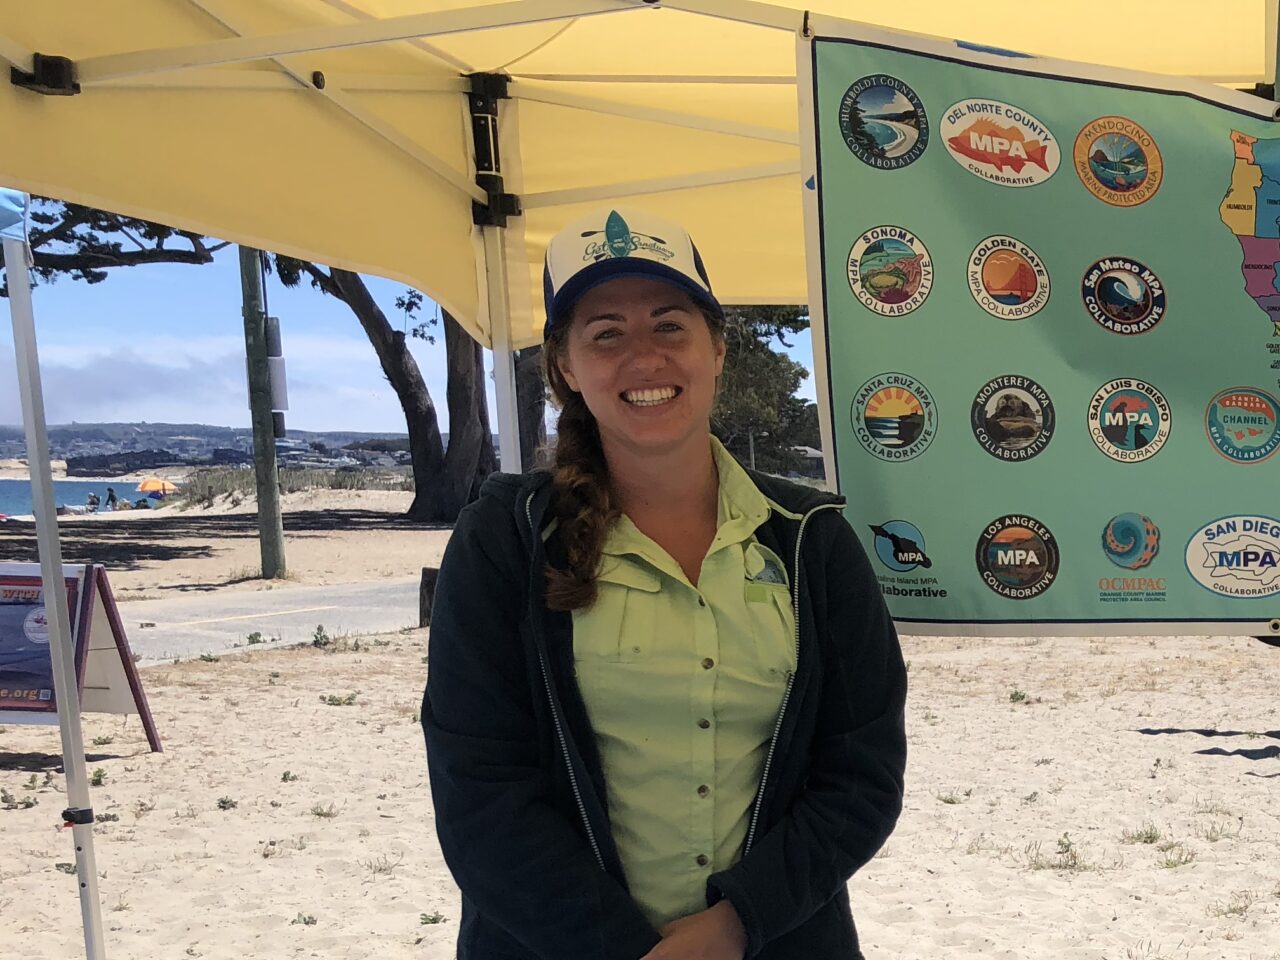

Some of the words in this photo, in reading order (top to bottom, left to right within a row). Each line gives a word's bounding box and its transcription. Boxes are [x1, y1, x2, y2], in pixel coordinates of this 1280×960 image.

[842, 77, 876, 120] HUMBOLDT
[880, 77, 918, 104] COUNTY
[947, 108, 966, 124] DEL
[966, 104, 1002, 115] NORTE
[1005, 109, 1051, 142] COUNTY
[1085, 121, 1150, 147] MENDOCINO
[847, 138, 925, 168] COLLABORATIVE
[970, 130, 1028, 159] MPA
[968, 163, 1034, 184] COLLABORATIVE
[862, 228, 915, 246] SONOMA
[973, 239, 1016, 266] GOLDEN
[1020, 248, 1045, 277] GATE
[850, 258, 859, 285] MPA
[858, 260, 931, 314] COLLABORATIVE
[1085, 269, 1101, 288] San
[1100, 260, 1139, 273] Mateo
[1141, 270, 1162, 297] MPA
[971, 271, 982, 296] MPA
[981, 282, 1048, 316] COLLABORATIVE
[1086, 296, 1162, 333] COLLABORATIVE
[857, 379, 884, 405] SANTA
[887, 376, 914, 389] CRUZ
[914, 386, 931, 408] MPA
[977, 377, 1030, 404] MONTEREY
[1030, 385, 1049, 407] MPA
[1091, 394, 1104, 421] SAN
[1104, 381, 1132, 394] LUIS
[1136, 382, 1169, 422] OBISPO
[1105, 412, 1153, 426] MPA
[1223, 415, 1269, 425] CHANNEL
[858, 427, 932, 458] COLLABORATIVE
[976, 428, 1050, 458] COLLABORATIVE
[1092, 427, 1166, 460] COLLABORATIVE
[1211, 427, 1222, 444] MPA
[984, 521, 1003, 539] LOS
[1005, 517, 1050, 540] ANGELES
[1205, 520, 1237, 541] SAN
[898, 552, 924, 562] MPA
[997, 550, 1040, 565] MPA
[1218, 551, 1277, 567] MPA
[984, 571, 1053, 597] COLLABORATIVE
[1099, 577, 1167, 590] OCMPAC
[1213, 582, 1280, 595] COLLABORATIVE
